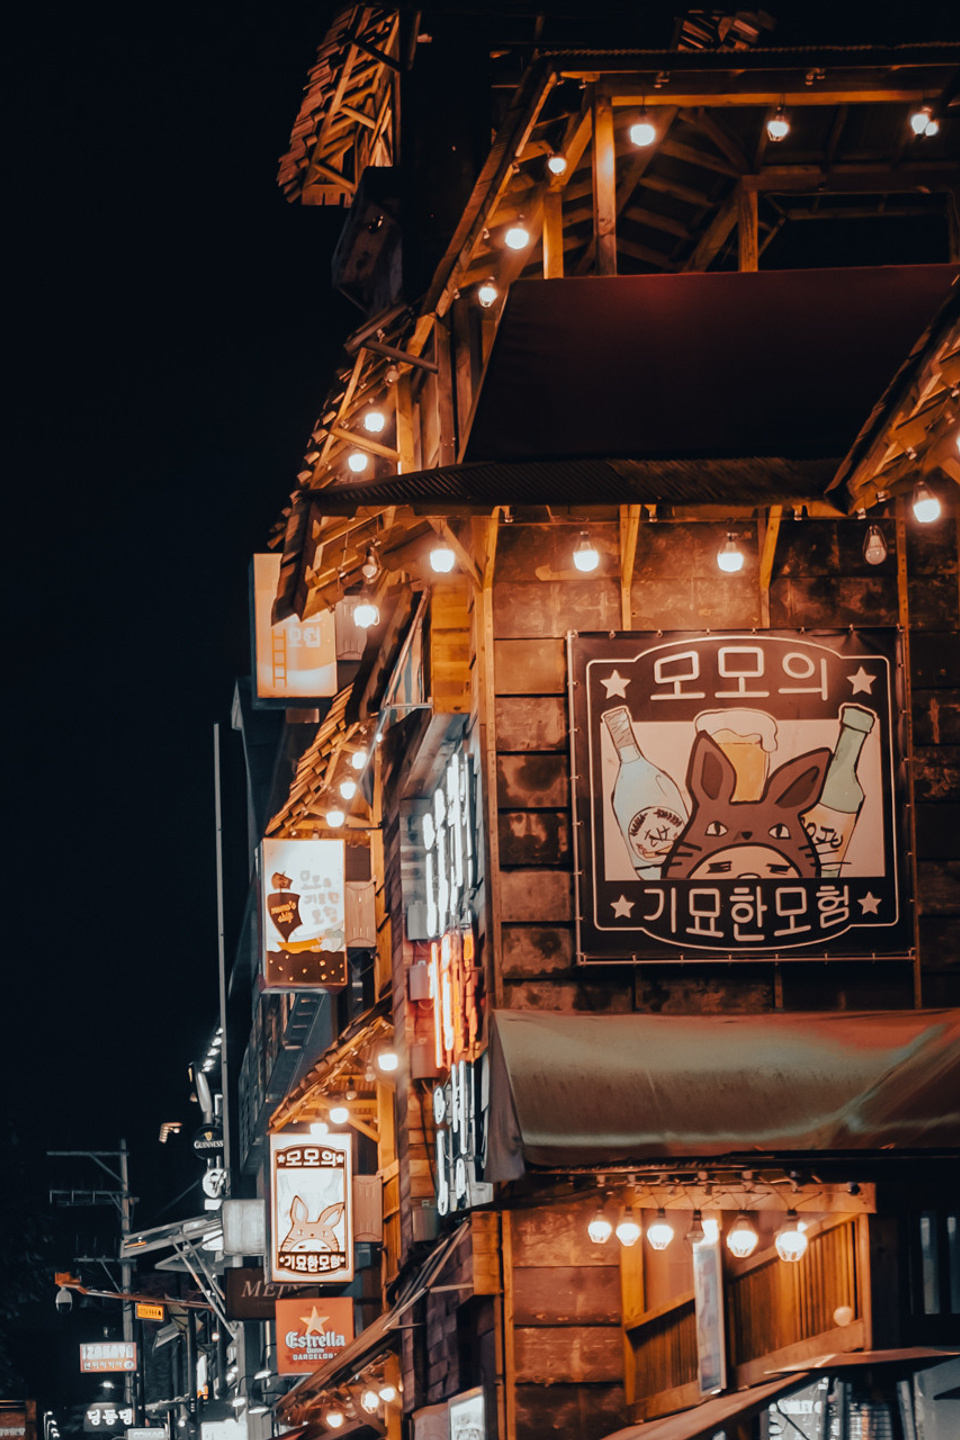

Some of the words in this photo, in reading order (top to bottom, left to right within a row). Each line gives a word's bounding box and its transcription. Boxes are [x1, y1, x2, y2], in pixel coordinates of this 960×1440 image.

[650, 647, 828, 701] 모모의
[285, 1149, 337, 1167] 모모의
[286, 1331, 345, 1348] Estrella
